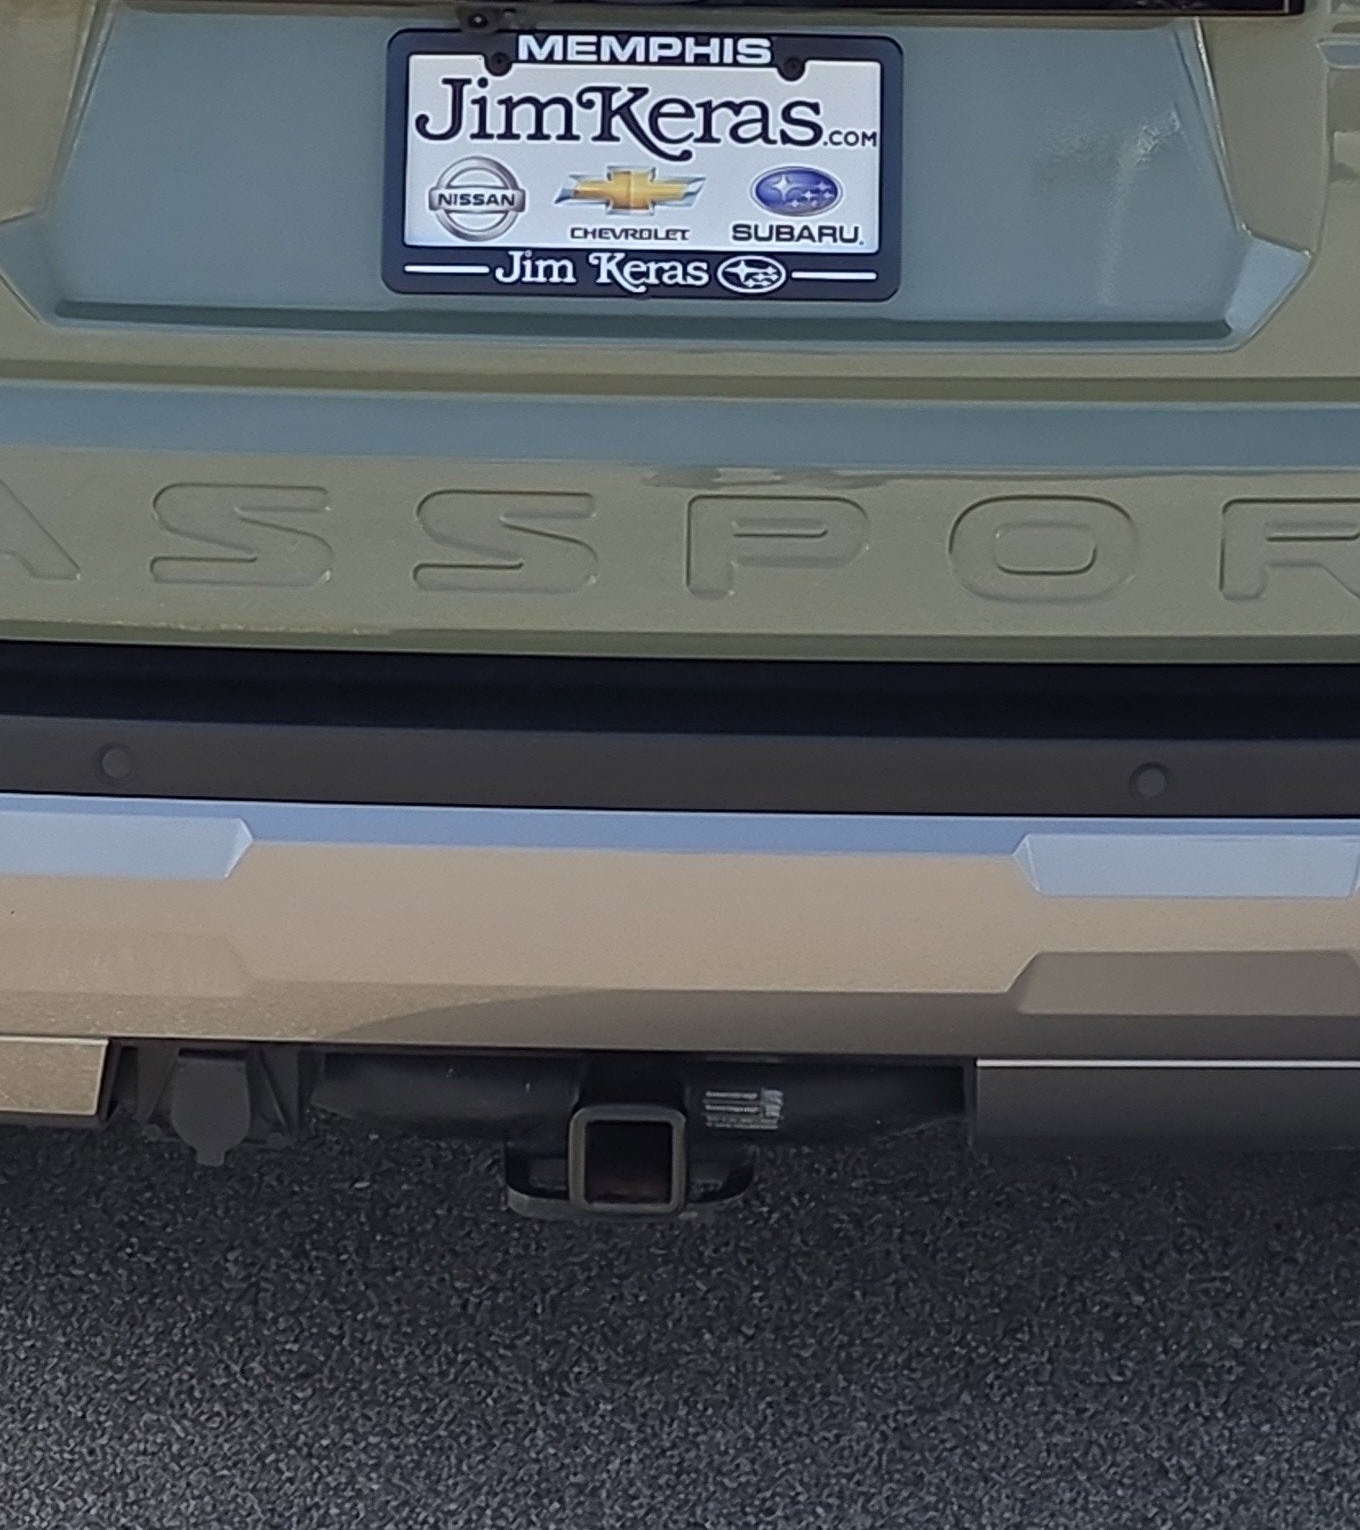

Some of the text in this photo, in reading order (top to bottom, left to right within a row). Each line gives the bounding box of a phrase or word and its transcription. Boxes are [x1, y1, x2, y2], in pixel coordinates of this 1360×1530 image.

[516, 33, 773, 65] MEMPHIS
[437, 191, 517, 208] NISSAN
[569, 226, 691, 242] CHEVROLET
[494, 249, 710, 293] Jim Keras
